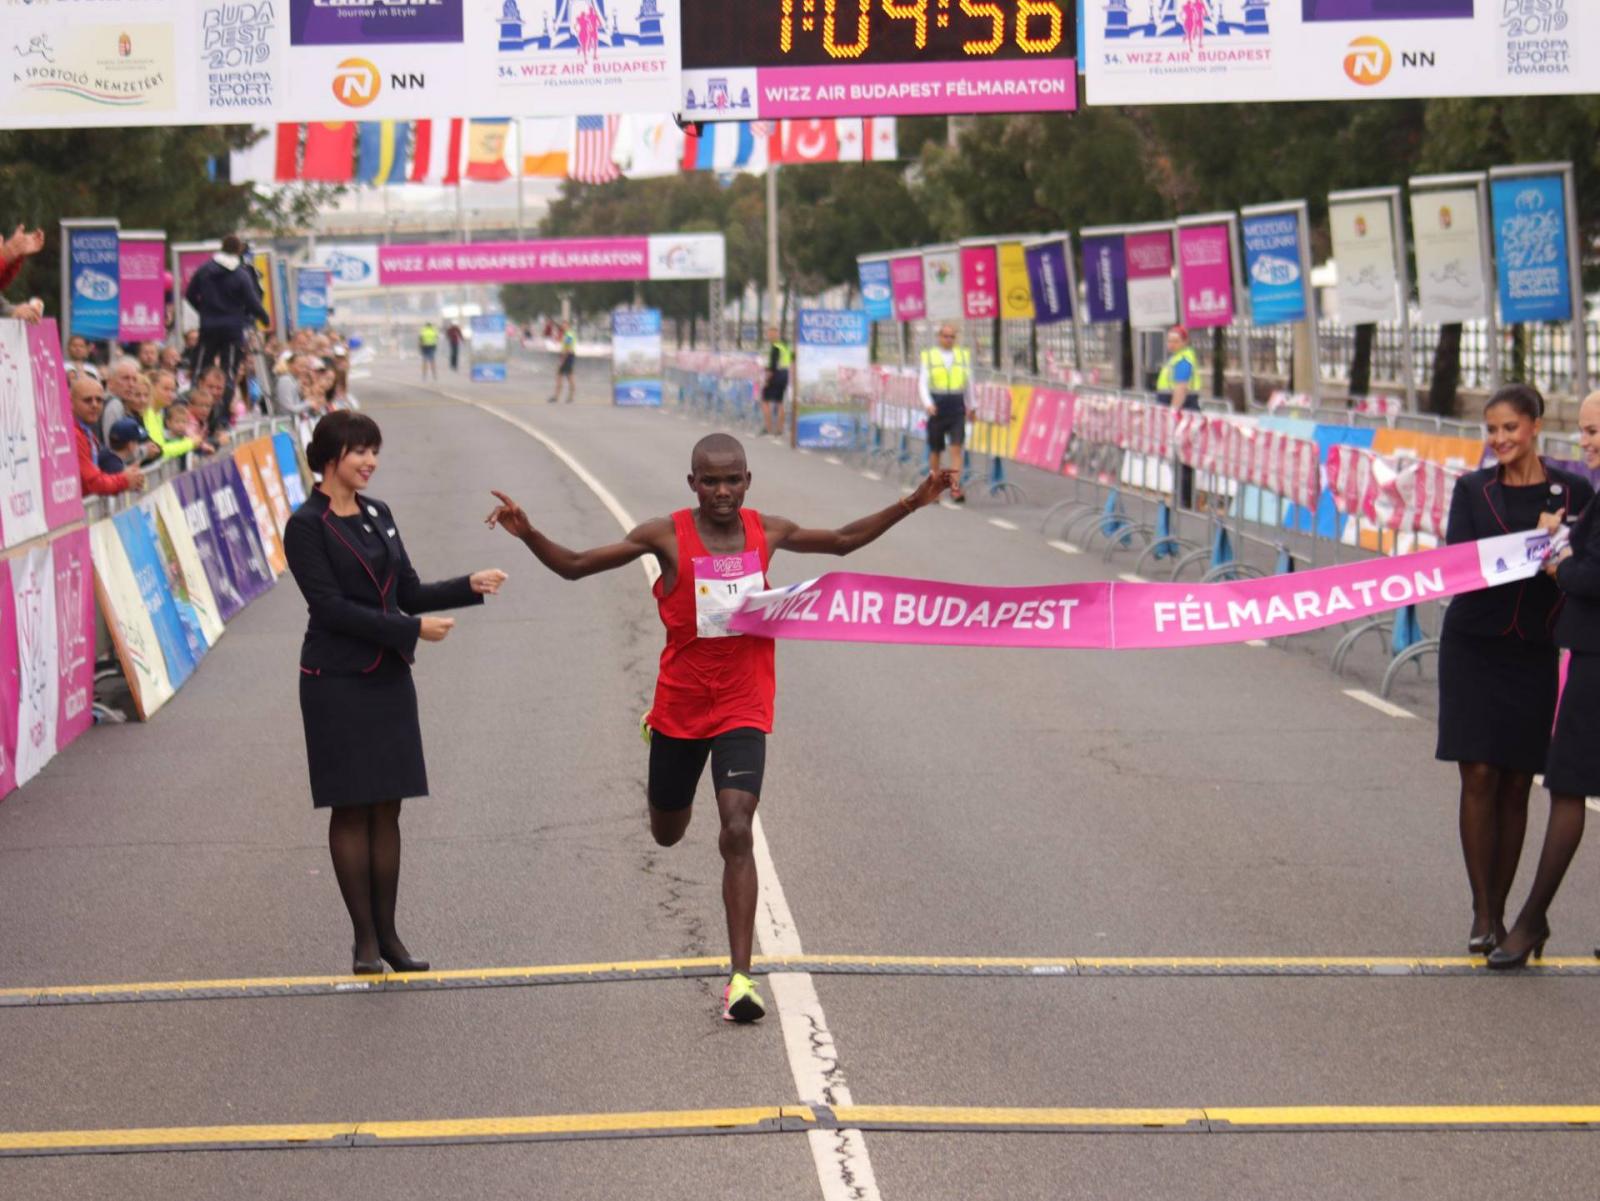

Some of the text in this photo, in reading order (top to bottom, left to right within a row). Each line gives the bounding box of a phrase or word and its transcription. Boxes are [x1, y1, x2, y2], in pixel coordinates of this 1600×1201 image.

[337, 7, 417, 19] Journey in Style
[781, 0, 1063, 58] 1:04:56
[1500, 10, 1568, 37] 2019
[201, 43, 270, 69] 2019
[1104, 49, 1272, 65] 34. WIZZ AIR BUDAPEST
[1402, 52, 1436, 67] NN
[13, 73, 22, 83] A
[26, 67, 89, 85] SPORTOLÓ
[499, 60, 667, 78] 34. WIZZ AIR BUDAPEST
[391, 74, 425, 89] NN
[765, 77, 1065, 101] WIZZ AIR BUDAPEST FÉLMARATON
[383, 257, 424, 272] WIZZ
[427, 256, 454, 271] AIR
[457, 252, 536, 270] BUDAPEST
[541, 250, 643, 268] FÉLMARATON
[726, 583, 738, 595] 11
[762, 567, 1446, 632] WIZZ AIR BUDAPEST FÉLMARATON
